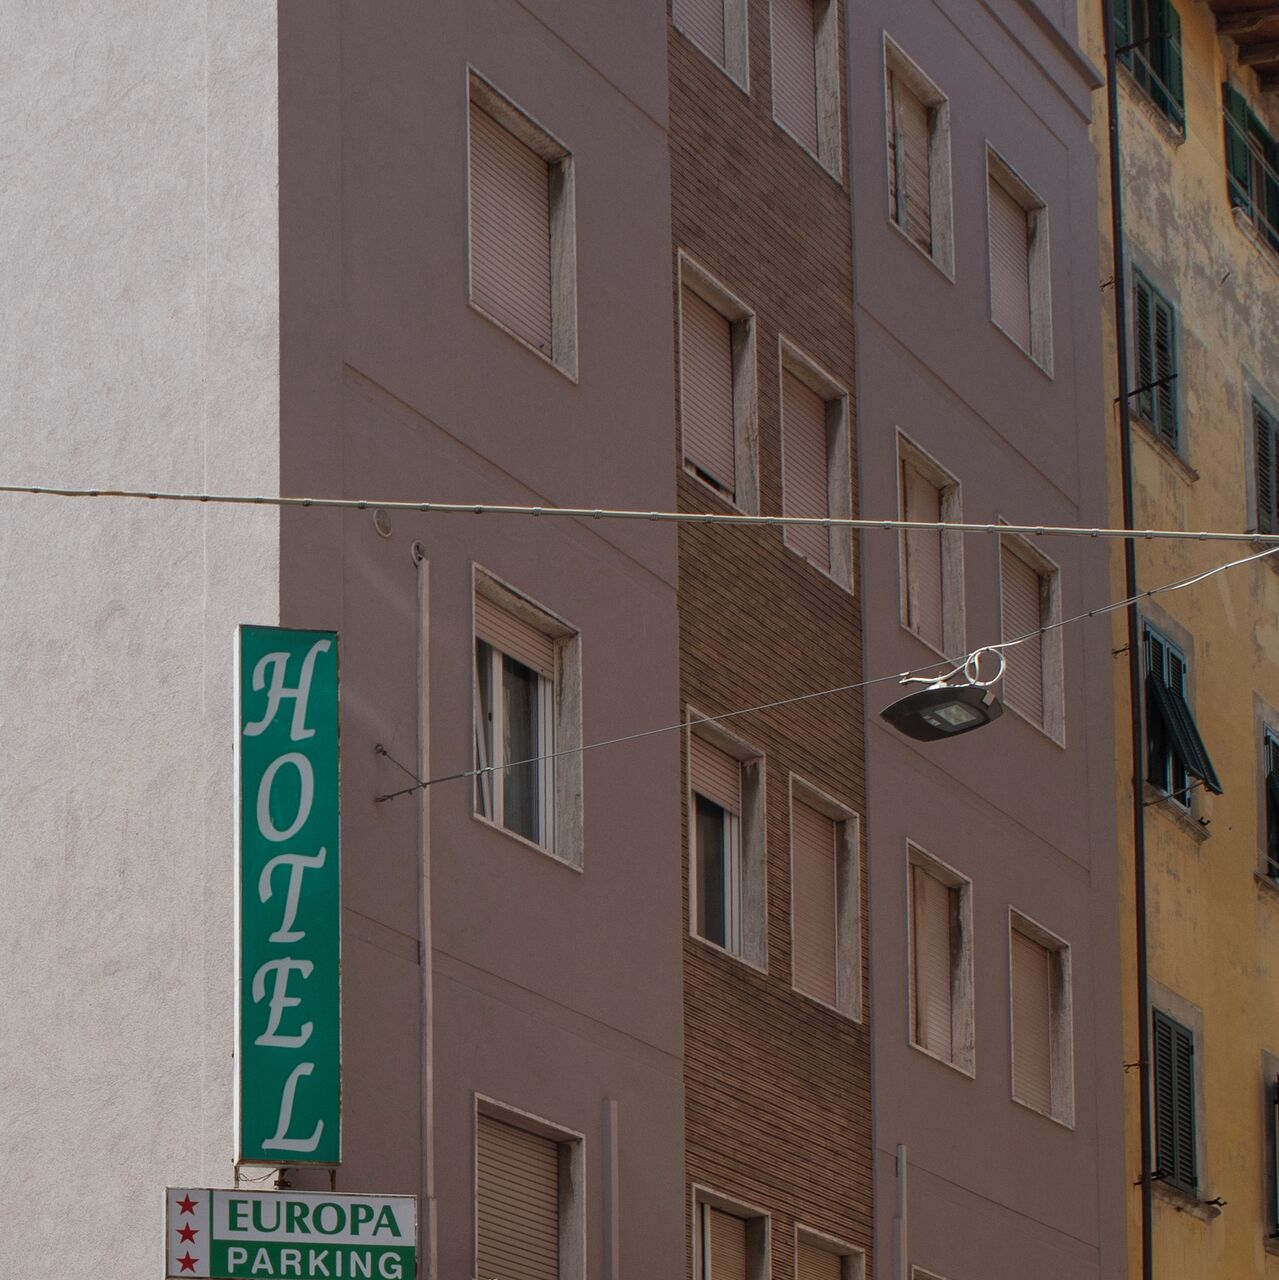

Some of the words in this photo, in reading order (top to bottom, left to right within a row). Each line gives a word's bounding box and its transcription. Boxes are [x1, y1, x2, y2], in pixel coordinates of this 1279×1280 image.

[242, 638, 332, 1153] HOTEL
[228, 1199, 402, 1238] EUROPA
[227, 1246, 403, 1280] PARKING
